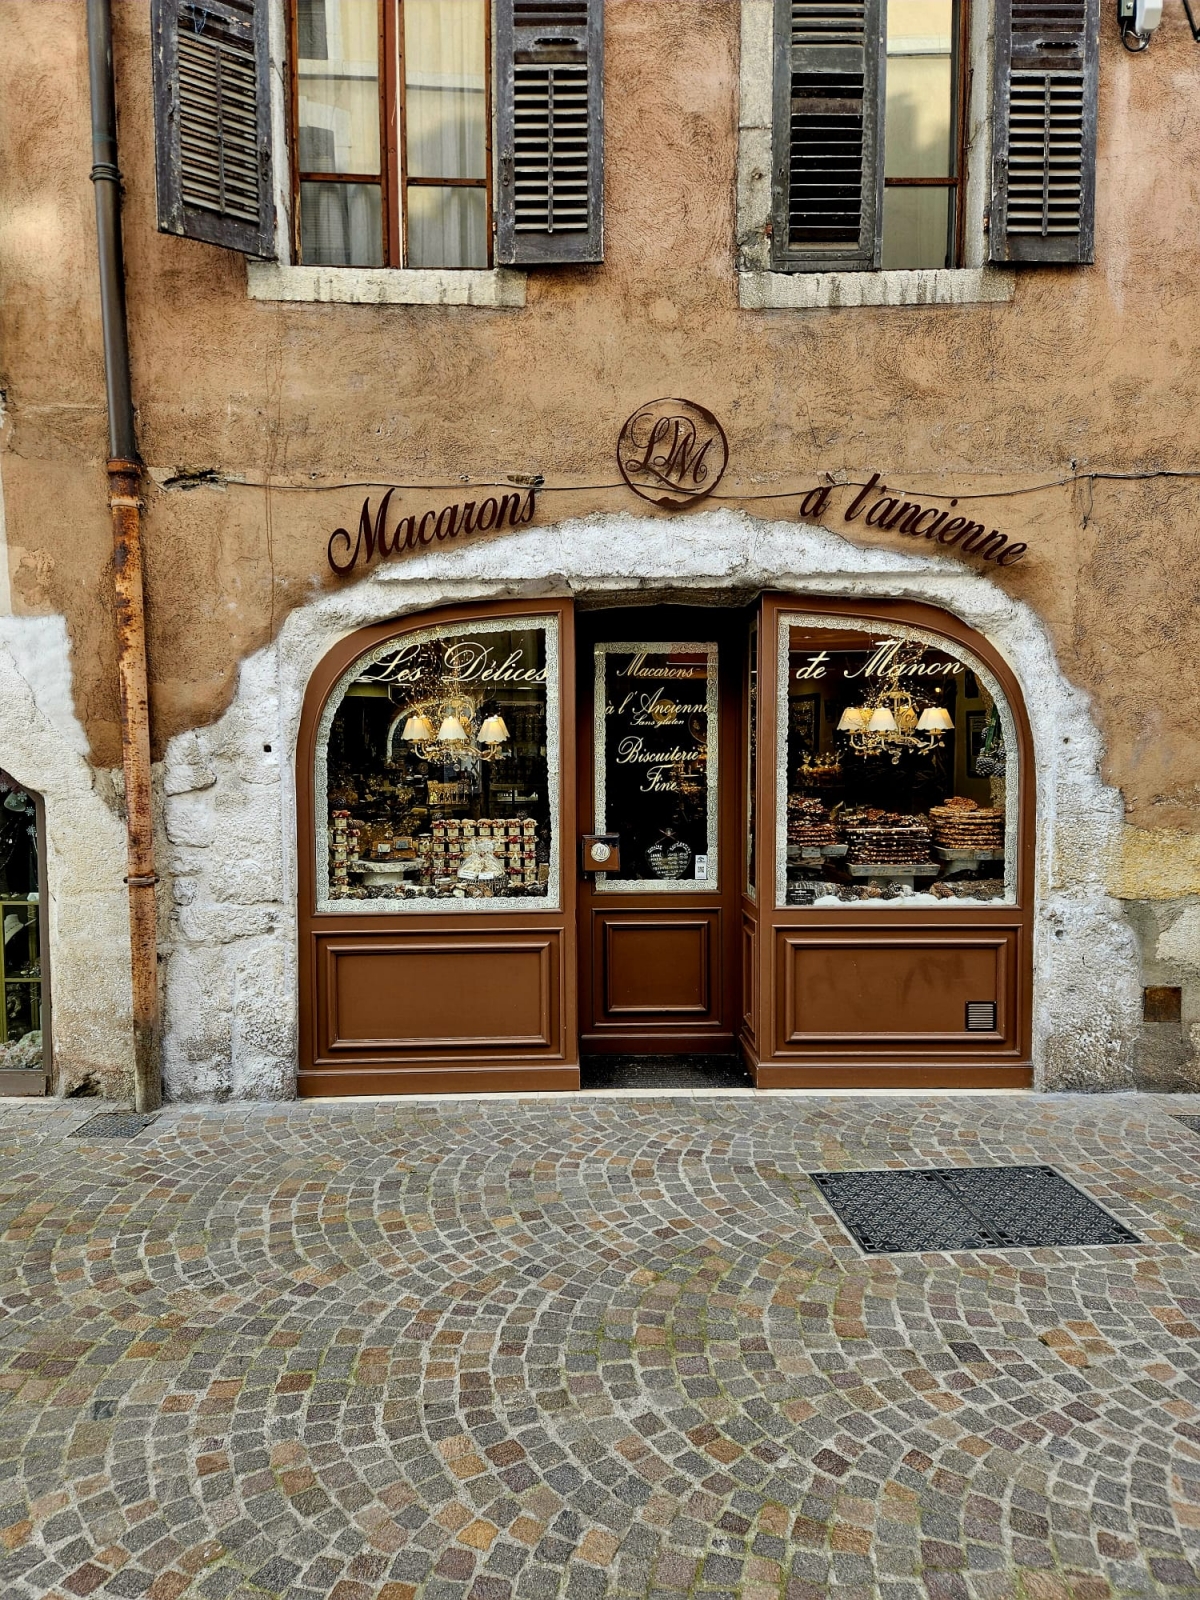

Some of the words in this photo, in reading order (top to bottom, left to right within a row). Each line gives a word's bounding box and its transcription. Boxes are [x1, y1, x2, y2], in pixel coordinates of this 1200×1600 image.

[327, 487, 536, 576] Macarons
[800, 472, 836, 518] à
[844, 473, 1028, 567] l'ancienne
[357, 643, 424, 682] Les
[441, 641, 549, 682] Délices
[616, 652, 695, 678] Macarons
[795, 650, 831, 680] de
[843, 637, 965, 679] Manon
[605, 699, 616, 715] à
[629, 711, 656, 726] Sans
[654, 716, 685, 729] gluten
[616, 735, 699, 764] Biscuiterie
[639, 763, 679, 792] Fine
